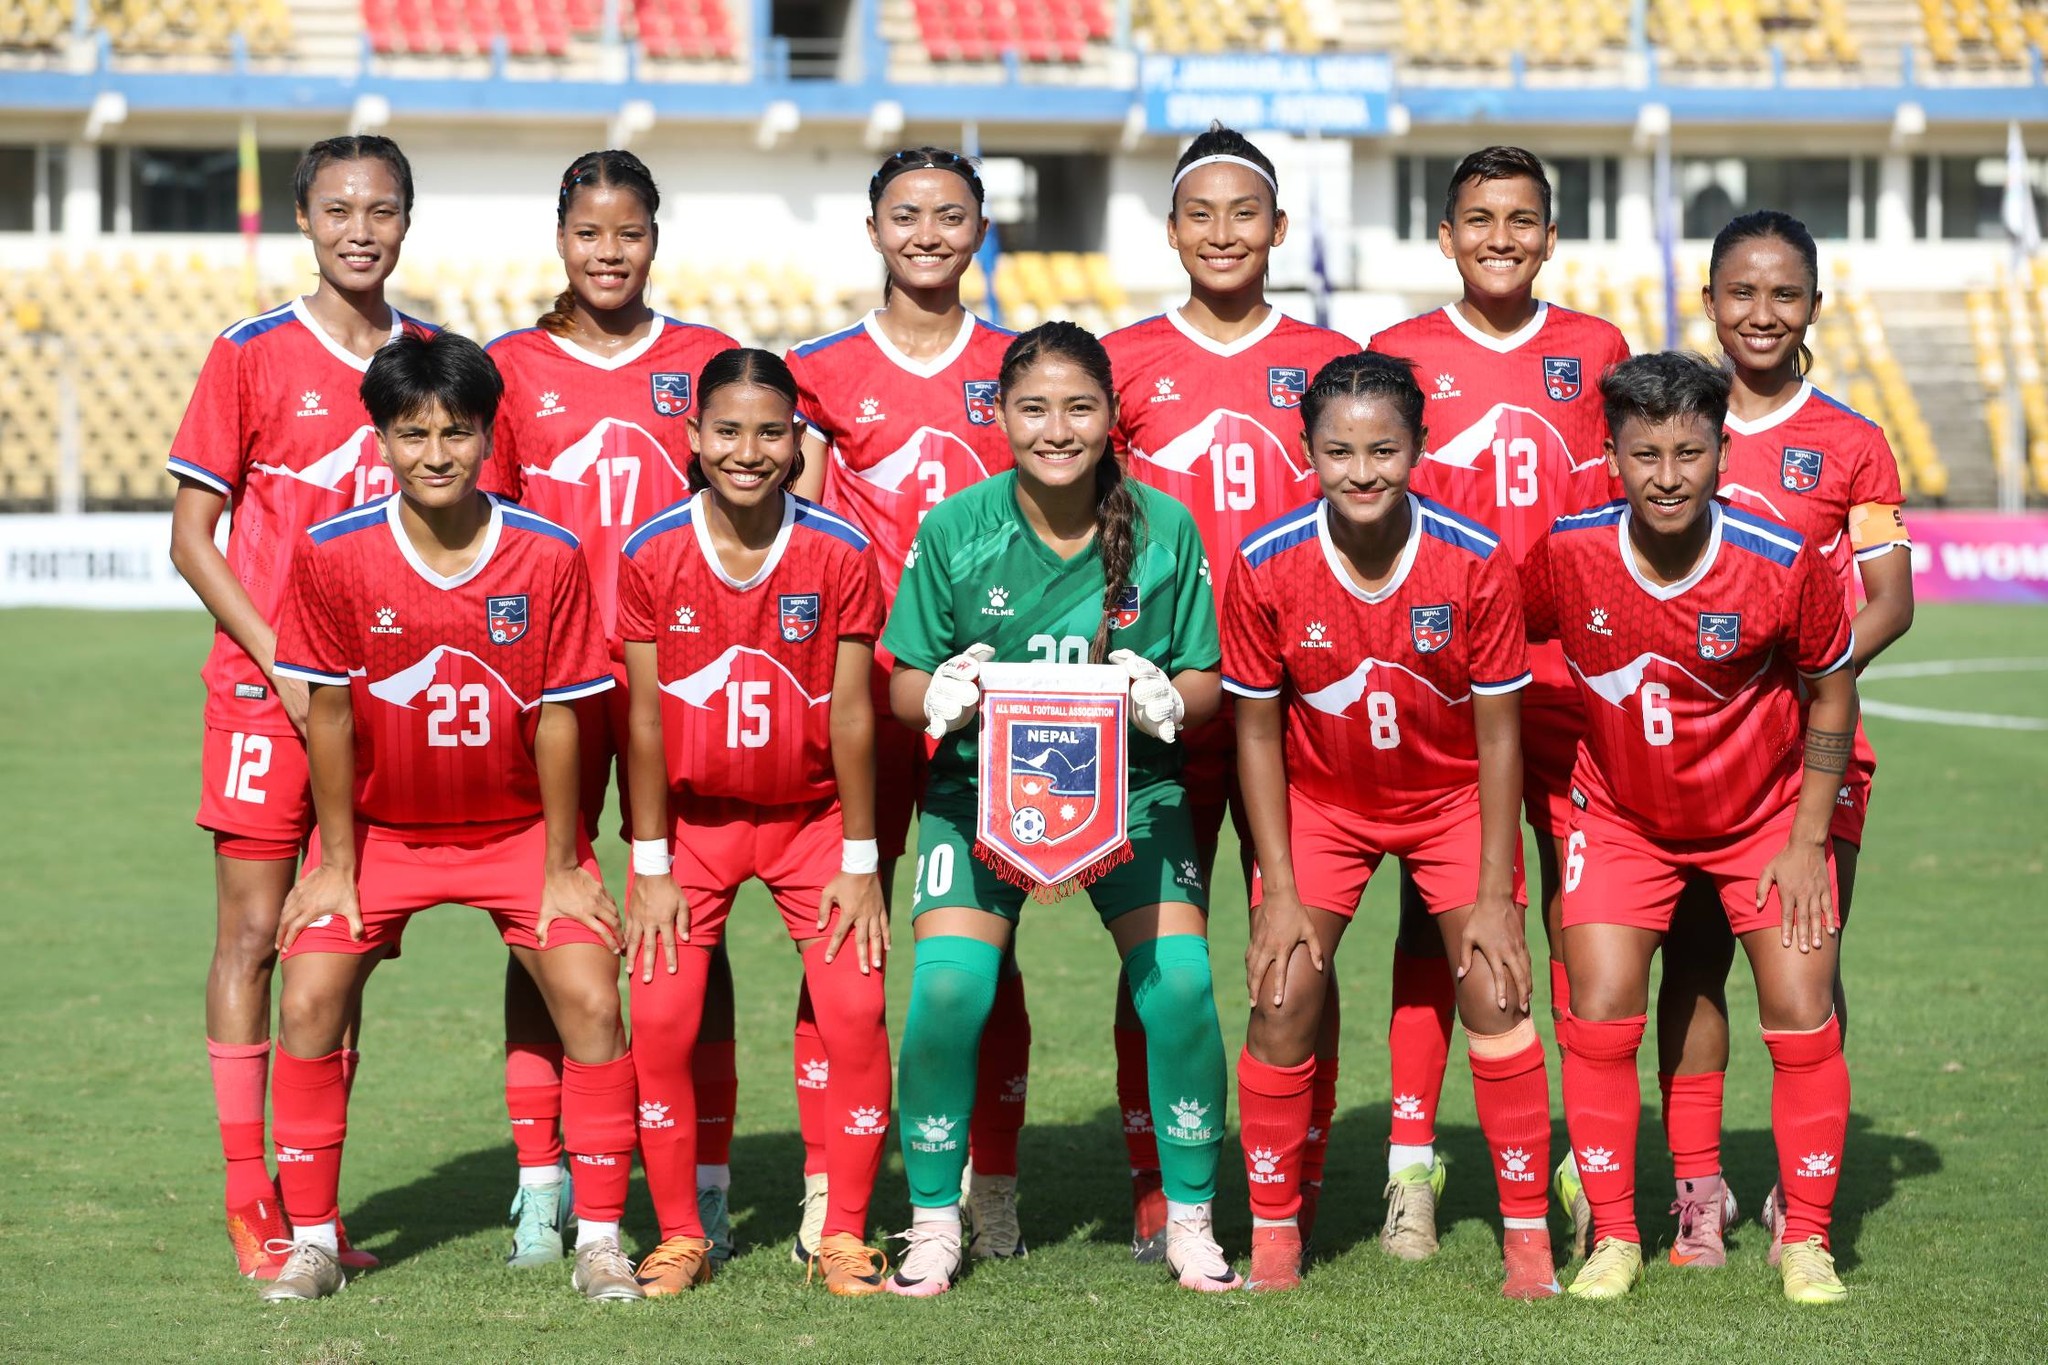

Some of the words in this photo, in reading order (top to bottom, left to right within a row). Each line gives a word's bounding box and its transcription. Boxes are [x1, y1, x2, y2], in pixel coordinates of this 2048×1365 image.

[1150, 393, 1181, 403] KELME
[1431, 389, 1462, 400] KELME
[296, 408, 329, 417] KELME
[536, 406, 566, 418] KELME
[855, 413, 886, 424] KELME
[1209, 442, 1256, 511] 19
[1492, 437, 1539, 507] 13
[596, 456, 641, 527] 17
[981, 607, 1015, 616] KELME
[1710, 617, 1728, 625] NEPAL
[370, 626, 403, 634] KELME
[669, 625, 701, 633] KELME
[1586, 623, 1613, 636] KELME
[426, 683, 491, 747] 23
[725, 681, 771, 748] 15
[996, 704, 1008, 714] ALL
[1009, 705, 1031, 715] NEPAL
[1033, 705, 1067, 716] FOOTBALL
[1068, 706, 1114, 717] ASSOCIATION
[1640, 682, 1674, 746] 6
[1366, 691, 1401, 750] 8
[1027, 729, 1080, 744] NEPAL
[224, 731, 273, 804] 12
[1564, 829, 1587, 894] 6
[1393, 1110, 1425, 1121] KELME
[844, 1126, 886, 1136] KELME
[1167, 1125, 1212, 1140] KELME
[912, 1141, 957, 1152] KELME
[277, 1153, 314, 1162] KELME
[577, 1155, 616, 1166] KELME
[1581, 1162, 1620, 1173] KELME
[1796, 1166, 1837, 1177] KELME
[1249, 1173, 1285, 1184] KELME
[1501, 1169, 1535, 1182] KELME
